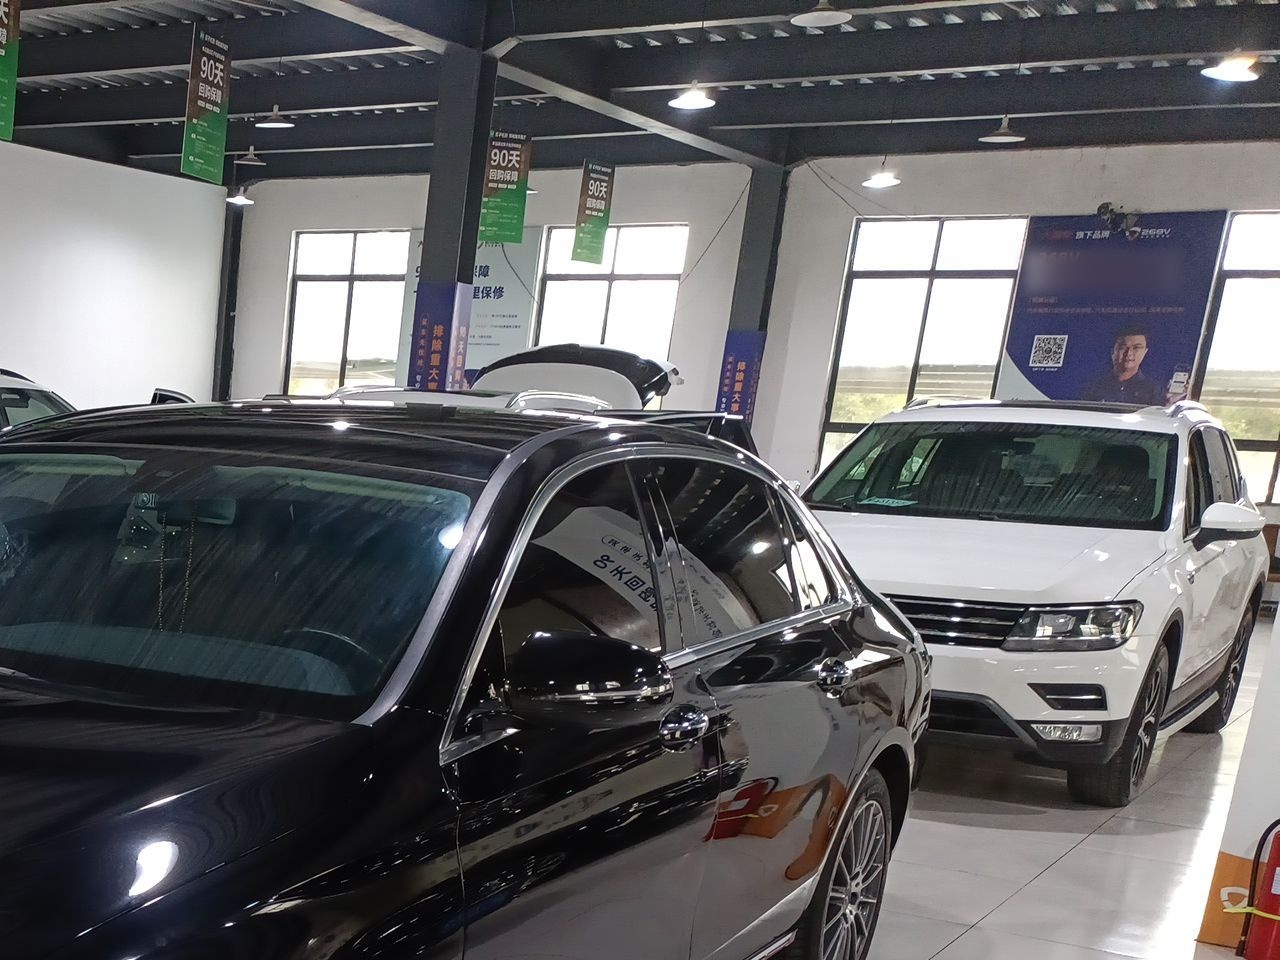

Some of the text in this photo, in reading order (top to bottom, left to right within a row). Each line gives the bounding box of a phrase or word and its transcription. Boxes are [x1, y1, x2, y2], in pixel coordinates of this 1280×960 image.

[200, 56, 223, 86] 90天
[198, 82, 222, 104] 回购保障
[491, 149, 520, 168] 90天
[489, 169, 518, 181] 回购保障
[588, 180, 608, 198] 90天
[1075, 230, 1111, 240] 旗下品牌
